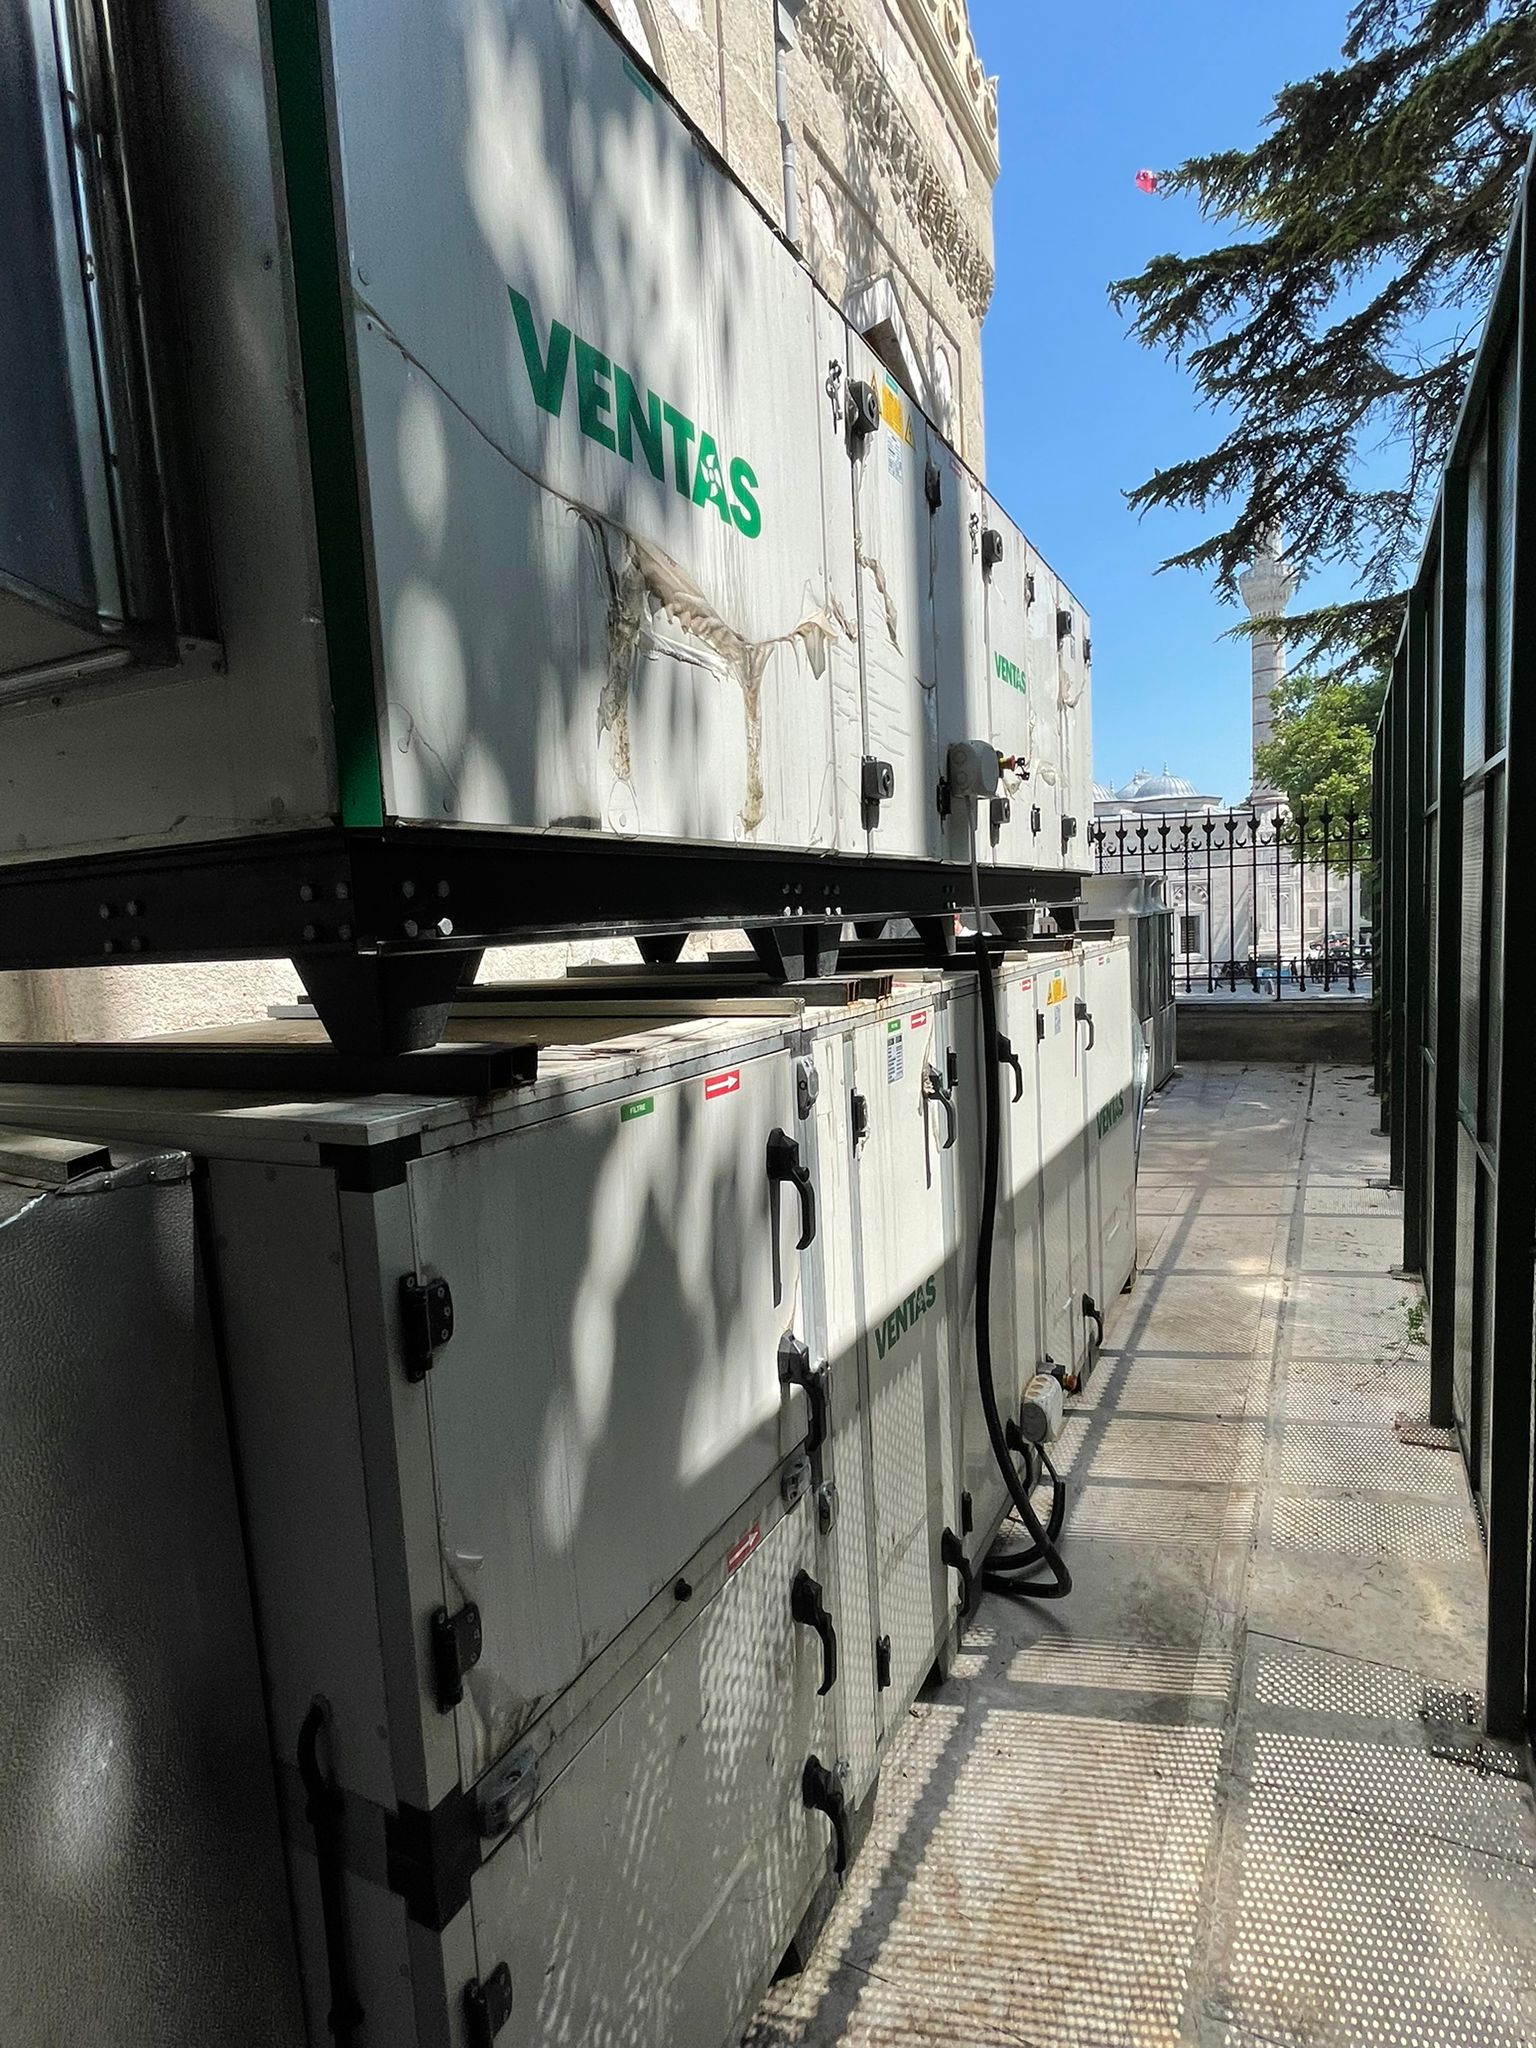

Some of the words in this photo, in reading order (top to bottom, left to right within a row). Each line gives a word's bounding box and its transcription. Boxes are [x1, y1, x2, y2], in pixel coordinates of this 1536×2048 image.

[507, 284, 761, 539] VENTAS
[994, 650, 1026, 694] VENTAS
[875, 1275, 936, 1360] VENTAS
